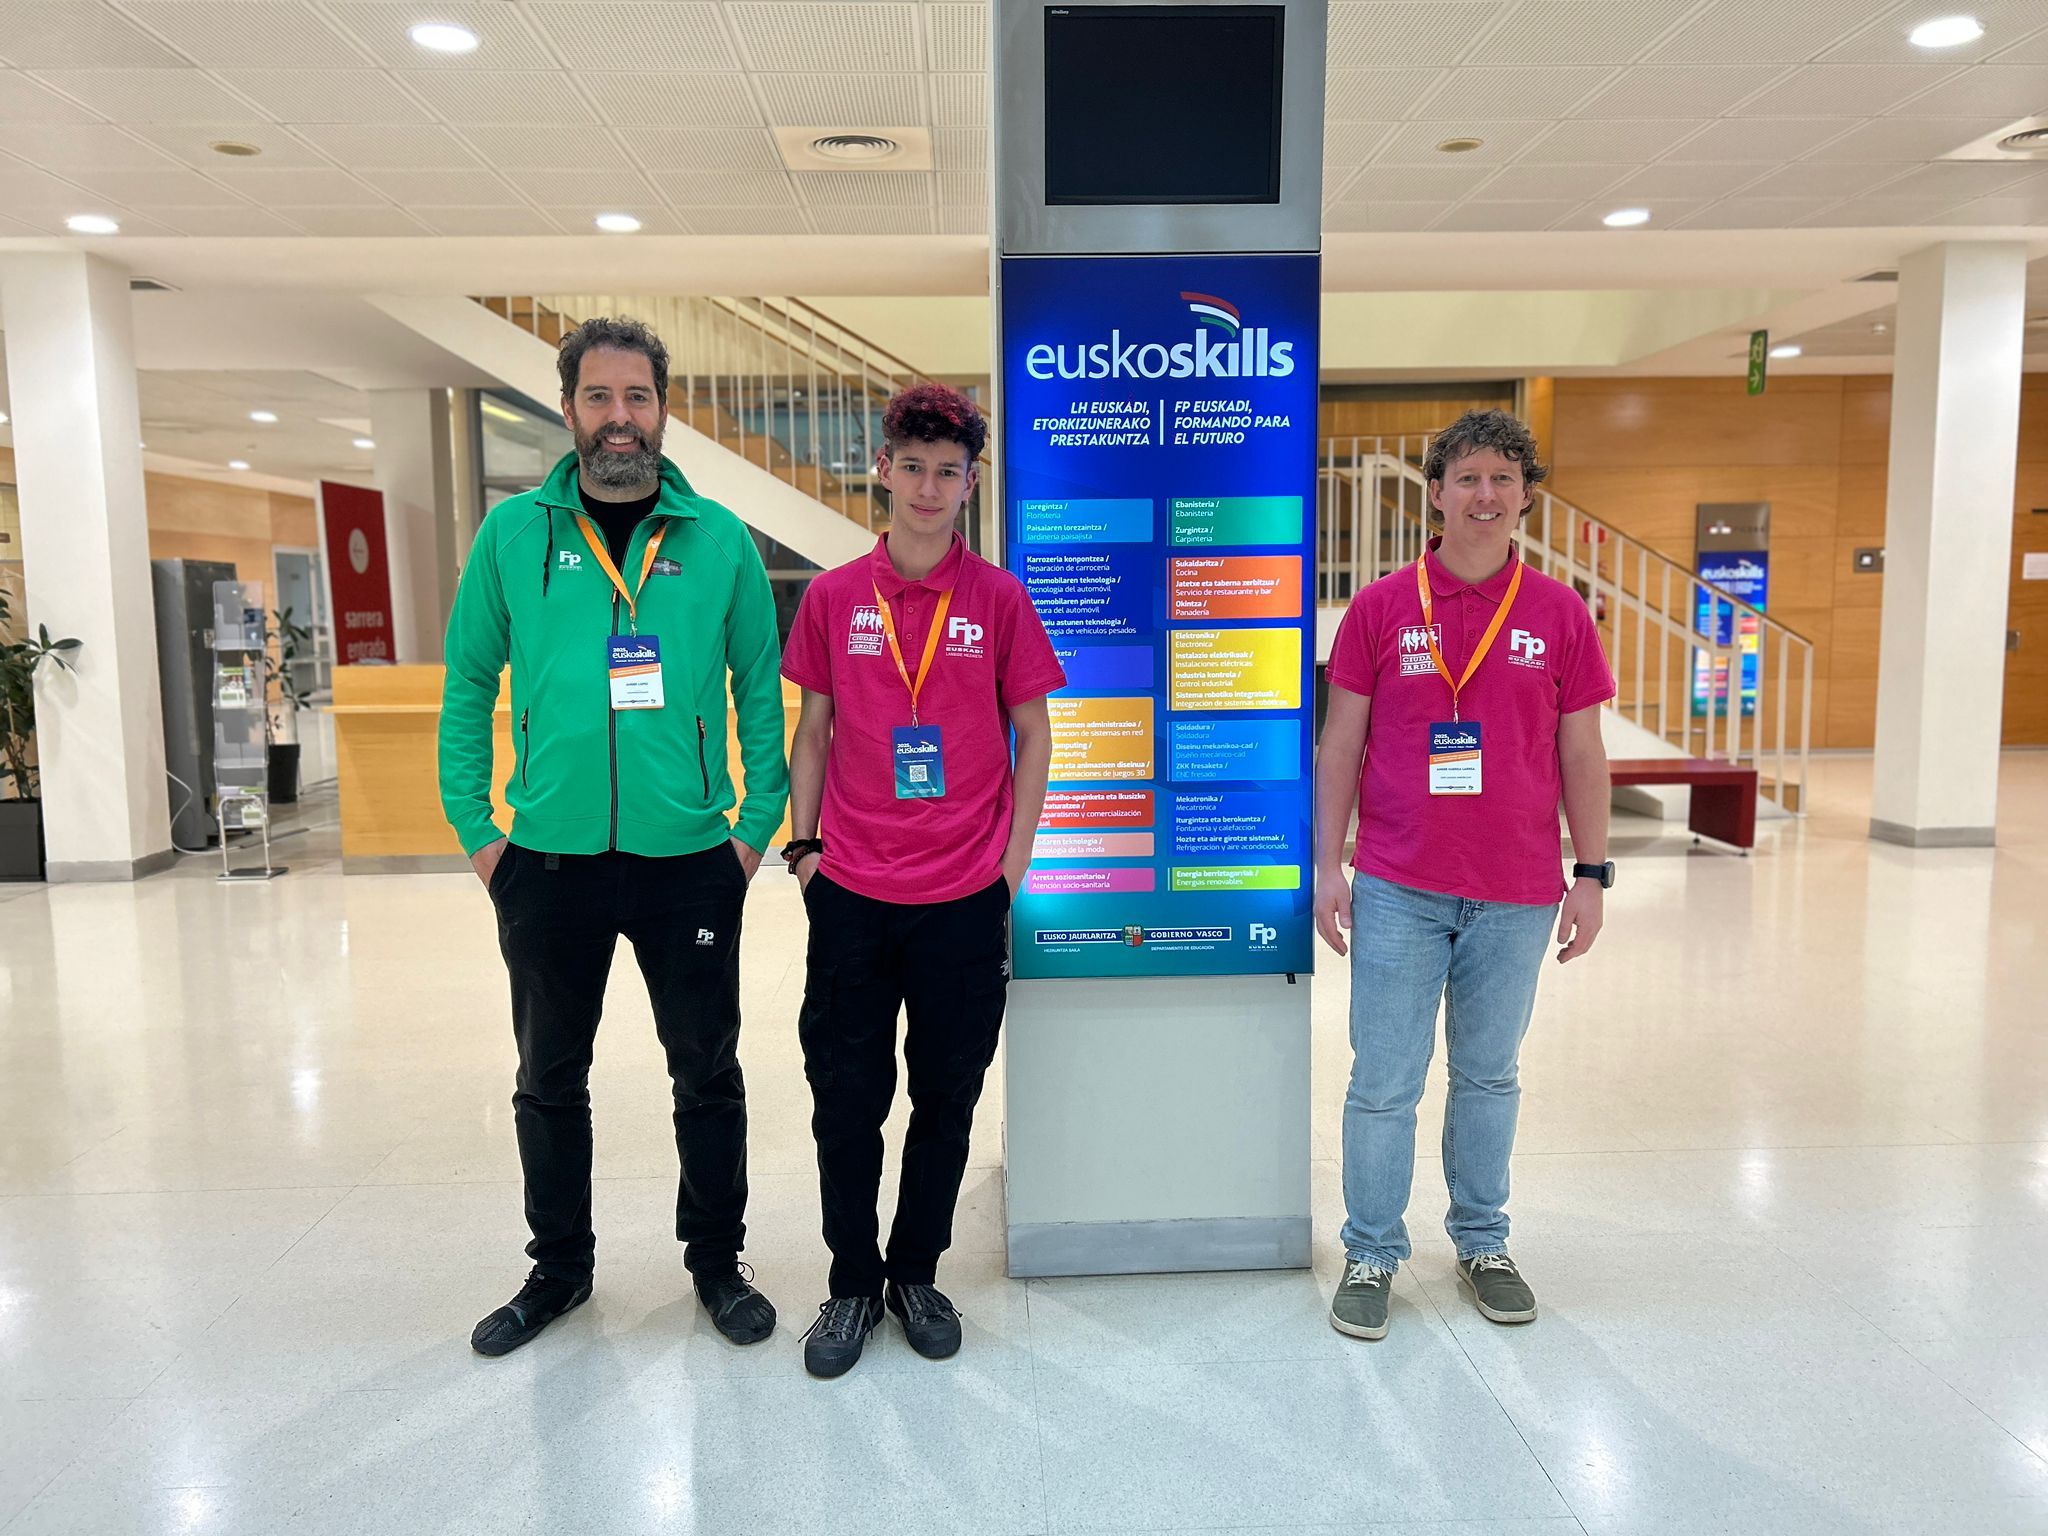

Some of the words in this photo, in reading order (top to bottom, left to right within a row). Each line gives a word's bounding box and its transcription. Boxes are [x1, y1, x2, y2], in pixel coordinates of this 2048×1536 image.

[1026, 328, 1294, 379] euskoskills
[1071, 402, 1088, 414] LH
[1090, 402, 1150, 415] EUSKADI,
[1174, 401, 1190, 413] FP
[1193, 400, 1252, 414] EUSKADI,
[1033, 418, 1150, 430] ETORKIZUNERAKO
[1174, 416, 1251, 429] FORMANDO
[1254, 416, 1290, 428] PARA
[1050, 434, 1150, 446] PRESTAKUNTZA
[1174, 433, 1189, 445] EL
[1193, 432, 1244, 444] FUTURO
[1027, 503, 1062, 511] Loregintza
[560, 551, 581, 565] Fp
[1080, 598, 1104, 606] pintura
[345, 611, 383, 628] sarrera
[1085, 618, 1121, 627] teknologia
[948, 617, 983, 645] Fp
[347, 637, 386, 659] entrada
[1511, 629, 1545, 659] Fp
[612, 650, 656, 658] euskoskills
[1508, 656, 1545, 666] EUSKADI
[1434, 736, 1477, 744] euskoskills
[897, 745, 938, 754] euskoskills
[698, 928, 714, 941] Fp
[1250, 924, 1276, 944] Fp
